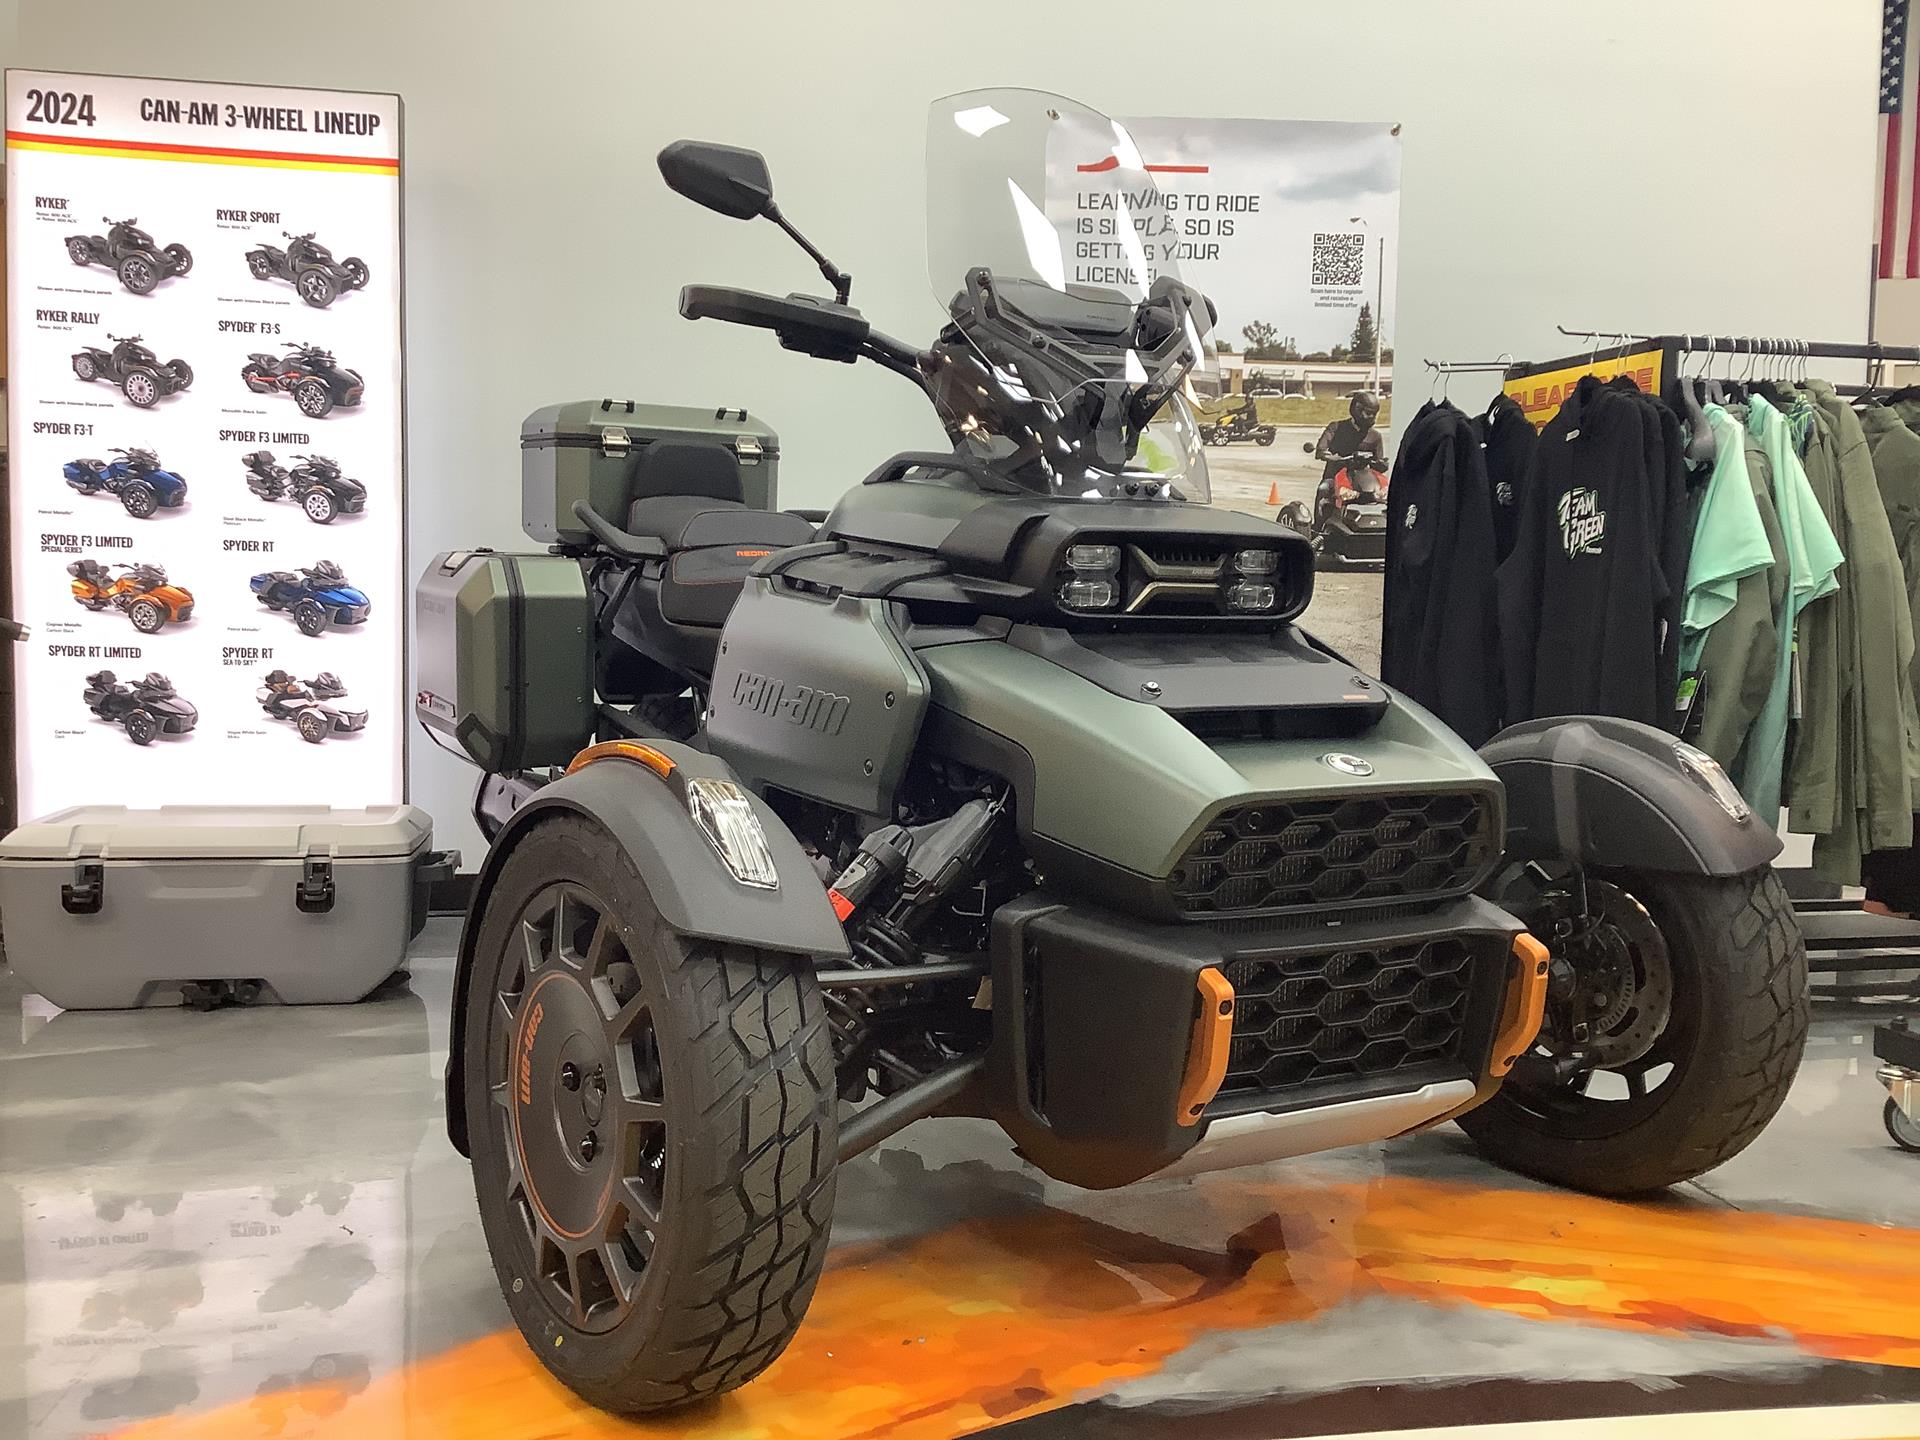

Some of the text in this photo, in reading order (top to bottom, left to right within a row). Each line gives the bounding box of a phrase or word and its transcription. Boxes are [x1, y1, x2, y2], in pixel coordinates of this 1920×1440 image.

[27, 89, 380, 136] 2024 CAN-AM 3-WHEEL LINEUP
[1184, 194, 1209, 211] TO
[1216, 195, 1260, 212] RIDE
[216, 209, 280, 224] RYKER SPORT
[1076, 218, 1093, 234] IS
[1185, 219, 1210, 236] SO
[1217, 219, 1234, 236] IS
[1076, 240, 1219, 261] GETTG YOUR
[36, 309, 100, 324] RYKER RALLY
[260, 322, 281, 335] F3-S
[1509, 367, 1654, 413] CLEARE
[33, 421, 94, 436] SPYDER F3-T
[219, 429, 310, 445] SPYDER F3 LIMITED
[1558, 489, 1597, 526] TEAM
[40, 534, 133, 549] SPYDER F3 LIMITED
[1564, 513, 1605, 555] GREEN
[41, 545, 63, 553] SPECIAL
[223, 539, 275, 553] SPYDER RT
[48, 645, 142, 659] SPYDER RT LIMITED
[222, 646, 274, 659] SPYDER RT
[731, 669, 850, 736] can-am
[521, 1002, 544, 1105] can-am
